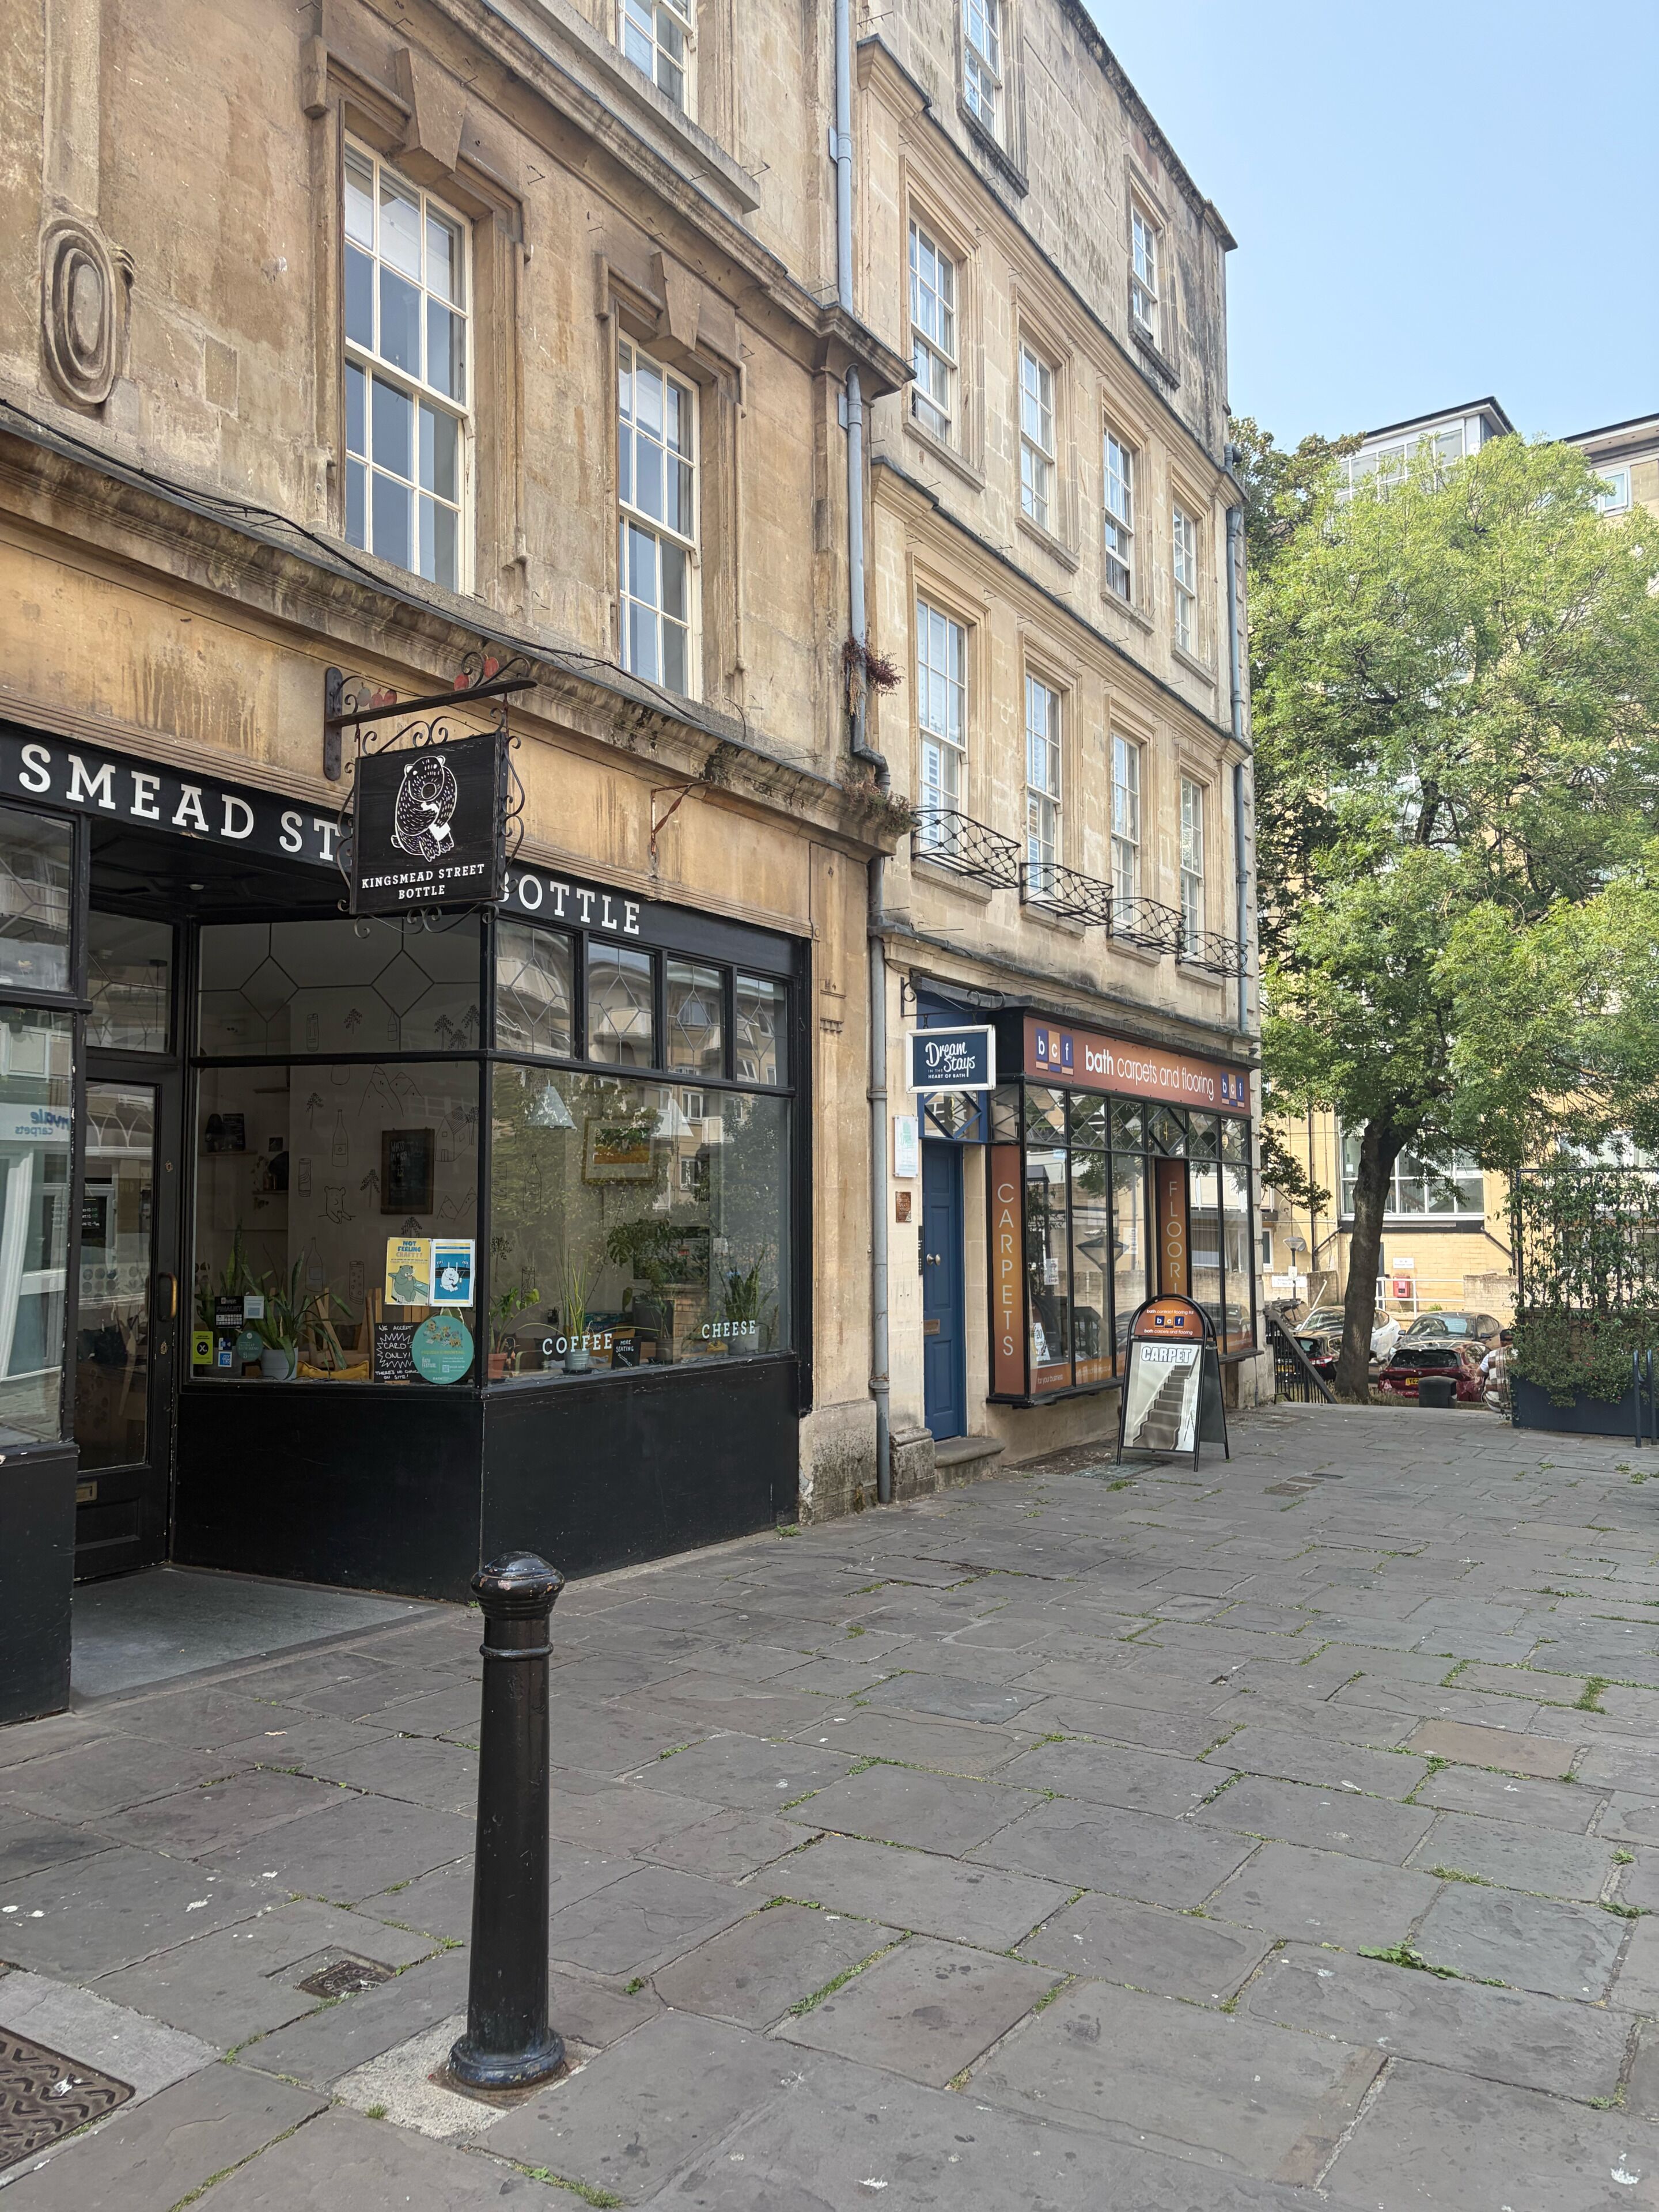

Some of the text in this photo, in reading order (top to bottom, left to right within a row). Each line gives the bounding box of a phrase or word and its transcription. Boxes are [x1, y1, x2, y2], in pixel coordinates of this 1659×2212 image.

[18, 744, 353, 866] SMEAD ST
[362, 864, 484, 889] KINGSMEAD STREET
[398, 885, 445, 900] BOTTLE
[925, 1041, 967, 1067] Dream
[943, 1056, 976, 1078] Stays
[1085, 1045, 1114, 1076] bath
[1117, 1058, 1157, 1086] carpets
[1160, 1065, 1179, 1089] and
[1181, 1067, 1214, 1101] flooring
[997, 1183, 1014, 1356] CARPETS
[702, 1320, 756, 1339] CHEESE
[542, 1333, 612, 1355] COFFEE
[1142, 1346, 1192, 1363] CARPET
